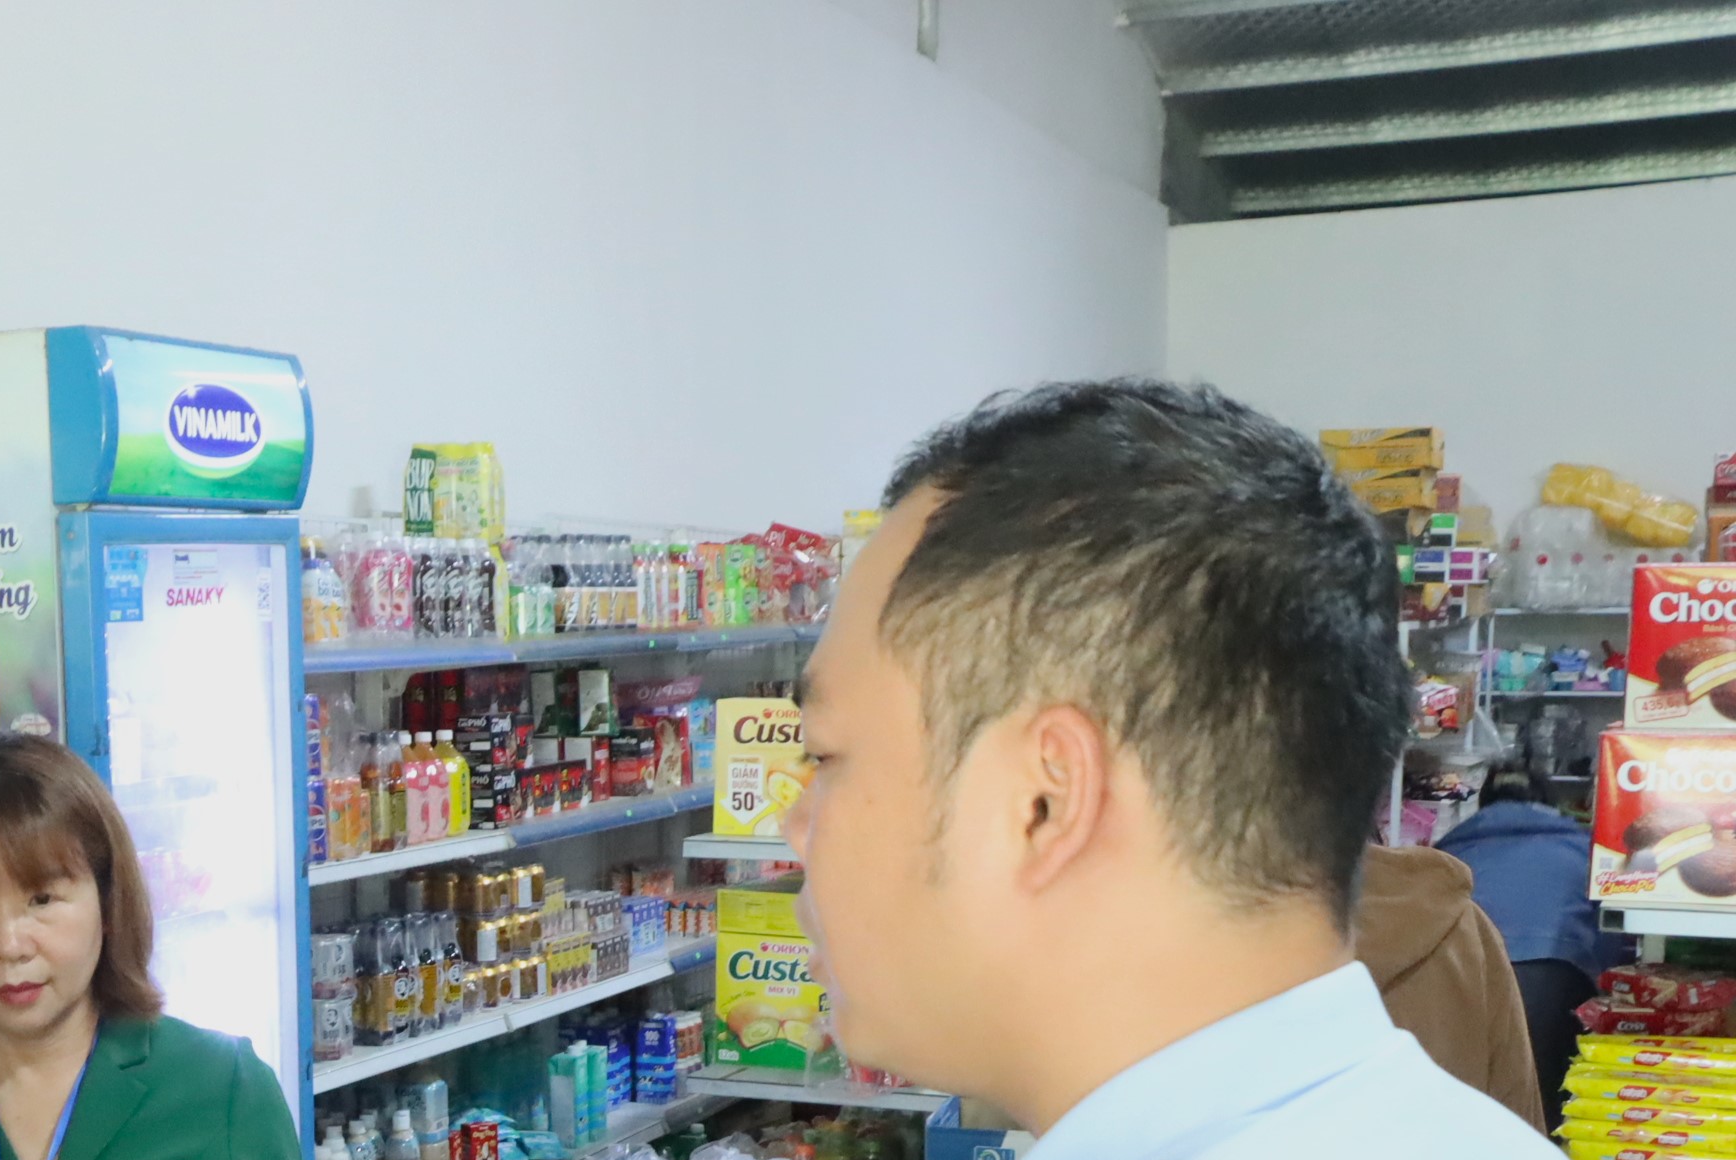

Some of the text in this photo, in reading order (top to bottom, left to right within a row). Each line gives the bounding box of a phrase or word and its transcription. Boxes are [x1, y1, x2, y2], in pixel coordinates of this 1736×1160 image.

[174, 405, 259, 443] VINAMILK
[166, 587, 225, 607] SANAKY
[733, 715, 804, 744] Cust
